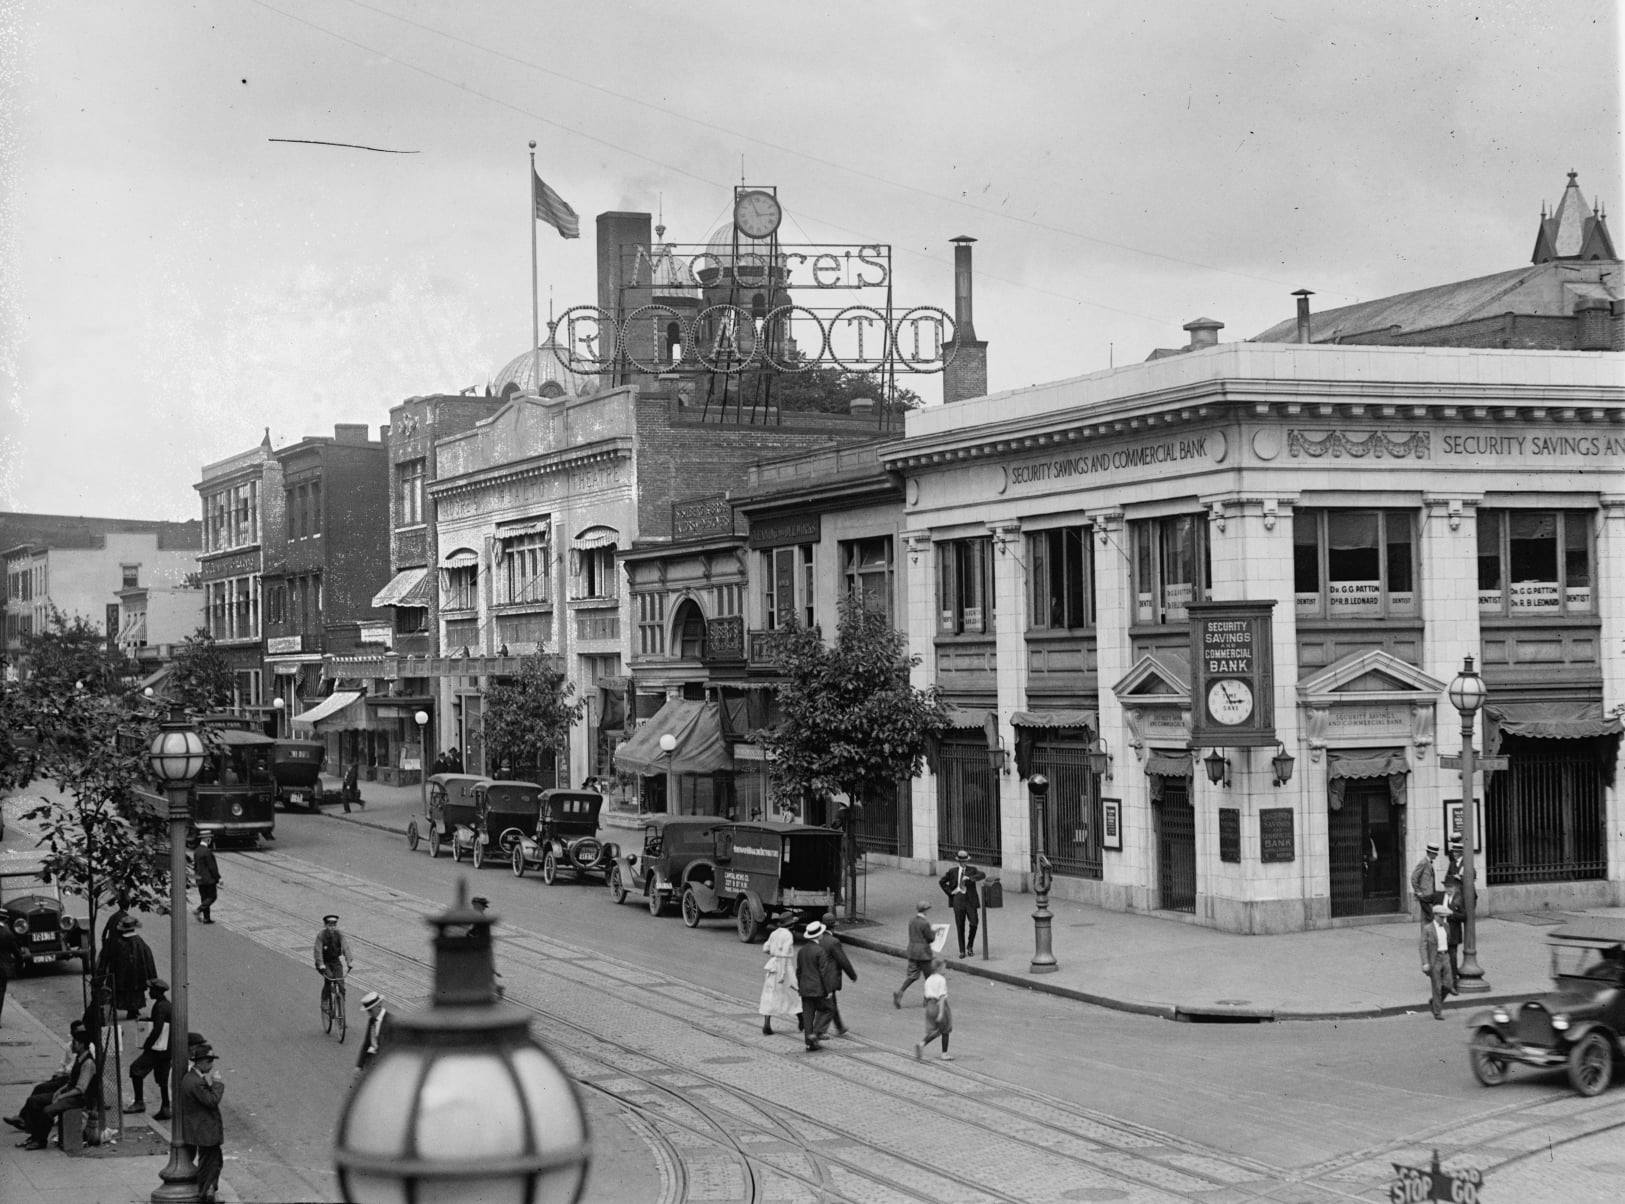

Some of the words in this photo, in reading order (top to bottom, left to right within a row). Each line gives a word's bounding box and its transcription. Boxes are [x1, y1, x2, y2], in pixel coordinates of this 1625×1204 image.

[1443, 435, 1527, 455] SECURITY
[1531, 436, 1600, 456] SAVINGS
[1012, 462, 1053, 485] SECURITY
[1053, 456, 1089, 479] SAVINGS
[1090, 453, 1110, 473] AND
[1112, 444, 1177, 469] COMMERCIAL
[1179, 437, 1208, 461] BANK
[1355, 585, 1380, 593] PATTON
[1208, 621, 1247, 632] SECURITY
[1205, 632, 1251, 643] SAVINGS
[1205, 648, 1252, 659] COMMERCIAL
[1209, 660, 1248, 672] BANK
[1264, 840, 1292, 848] BANK
[1392, 1175, 1433, 1204] STOP
[1451, 1179, 1477, 1204] GO
